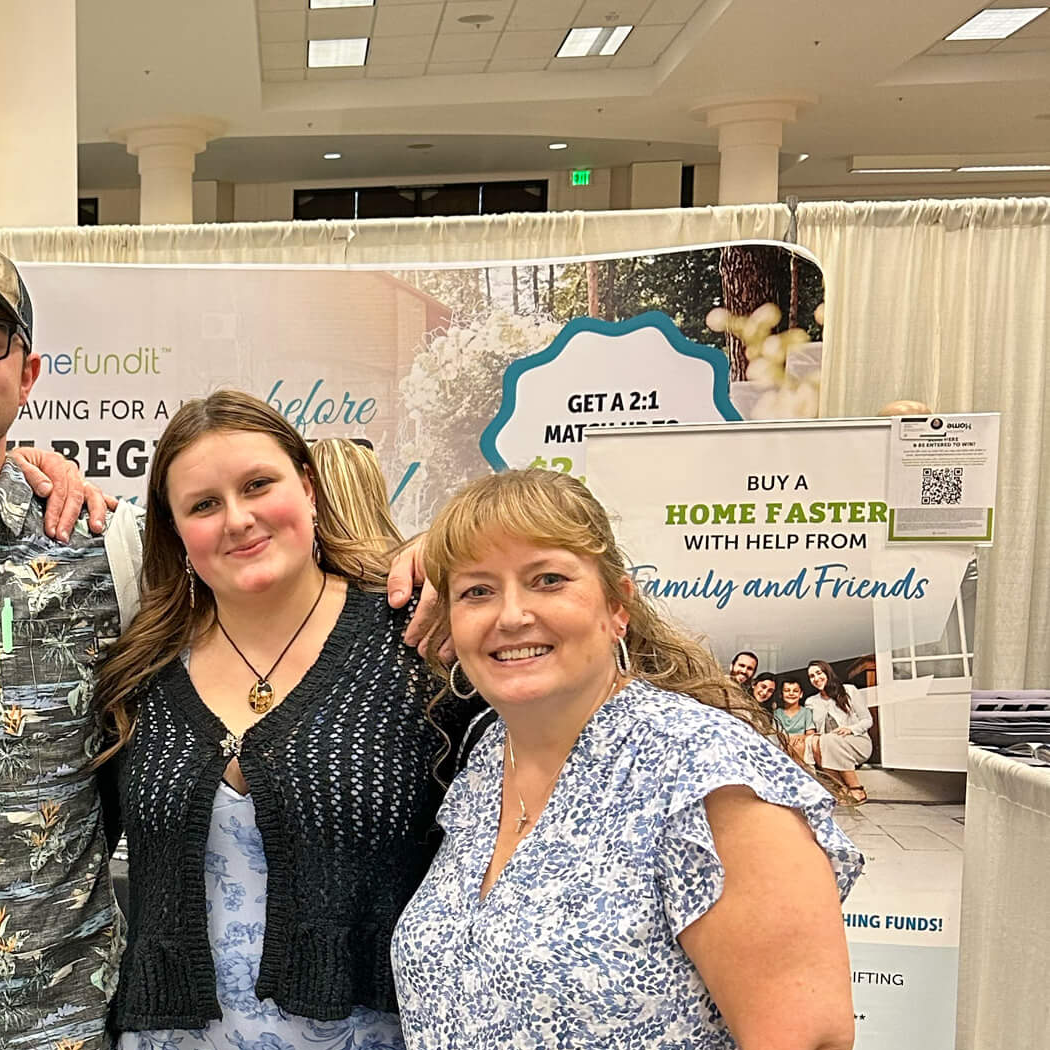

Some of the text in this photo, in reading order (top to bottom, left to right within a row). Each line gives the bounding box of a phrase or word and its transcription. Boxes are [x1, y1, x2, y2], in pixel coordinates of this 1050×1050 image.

[100, 400, 144, 420] FOR
[154, 400, 169, 420] A
[568, 391, 659, 413] GET A 2:1
[51, 438, 162, 478] BEG
[747, 474, 808, 491] BUY A
[665, 503, 756, 525] HOME
[765, 501, 888, 524] FASTER
[684, 533, 867, 550] WITH HELP FROM
[628, 563, 929, 610] Family and Friends
[885, 915, 943, 932] FUNDS!
